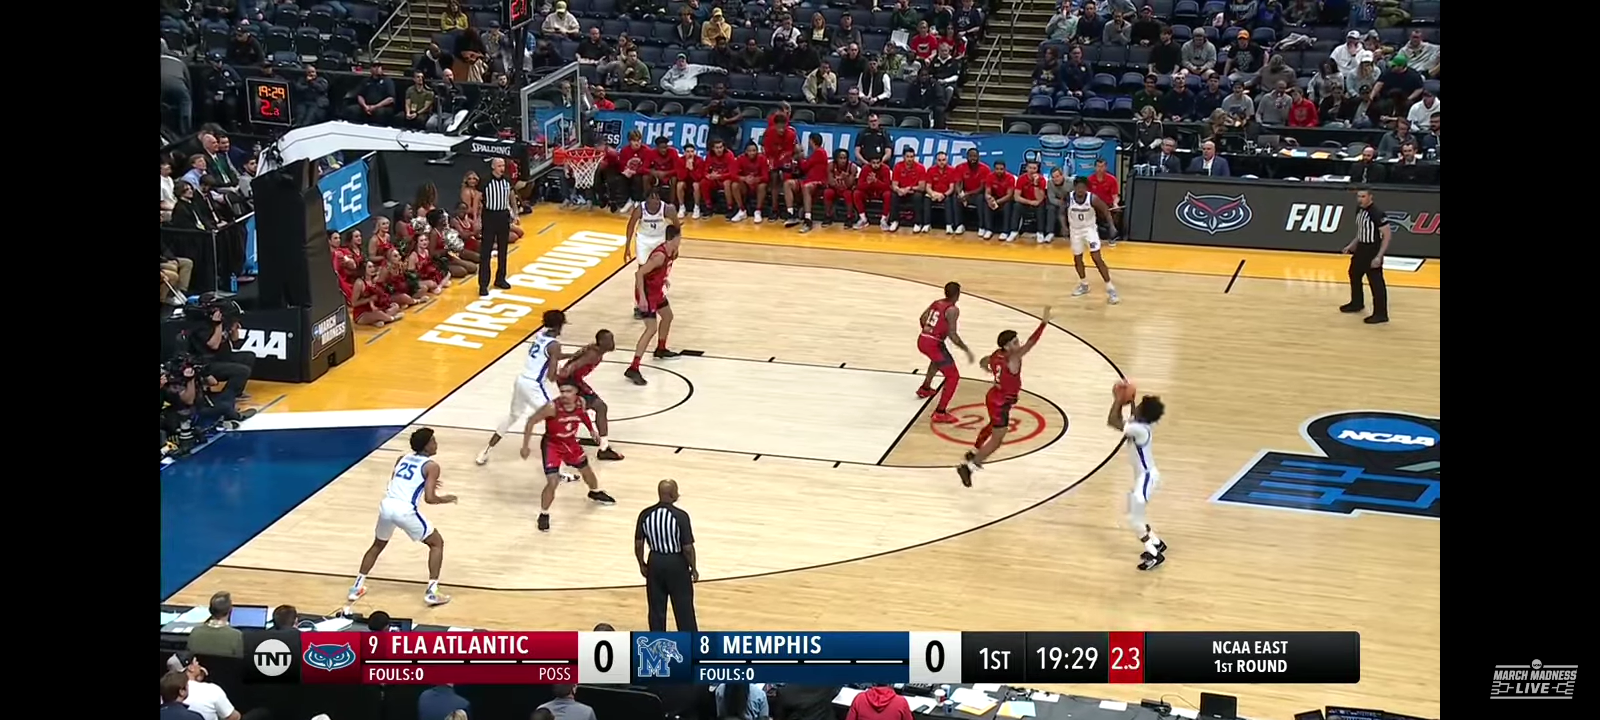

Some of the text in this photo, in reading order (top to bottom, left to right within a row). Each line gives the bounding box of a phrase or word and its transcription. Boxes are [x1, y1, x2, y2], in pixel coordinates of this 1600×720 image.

[258, 85, 285, 99] 19:29
[471, 142, 511, 156] SPALDING
[1286, 203, 1343, 233] FAU
[417, 230, 628, 350] FIRST ROUND
[926, 310, 940, 327] 15
[1337, 429, 1435, 447] NCAA
[395, 462, 418, 481] 25
